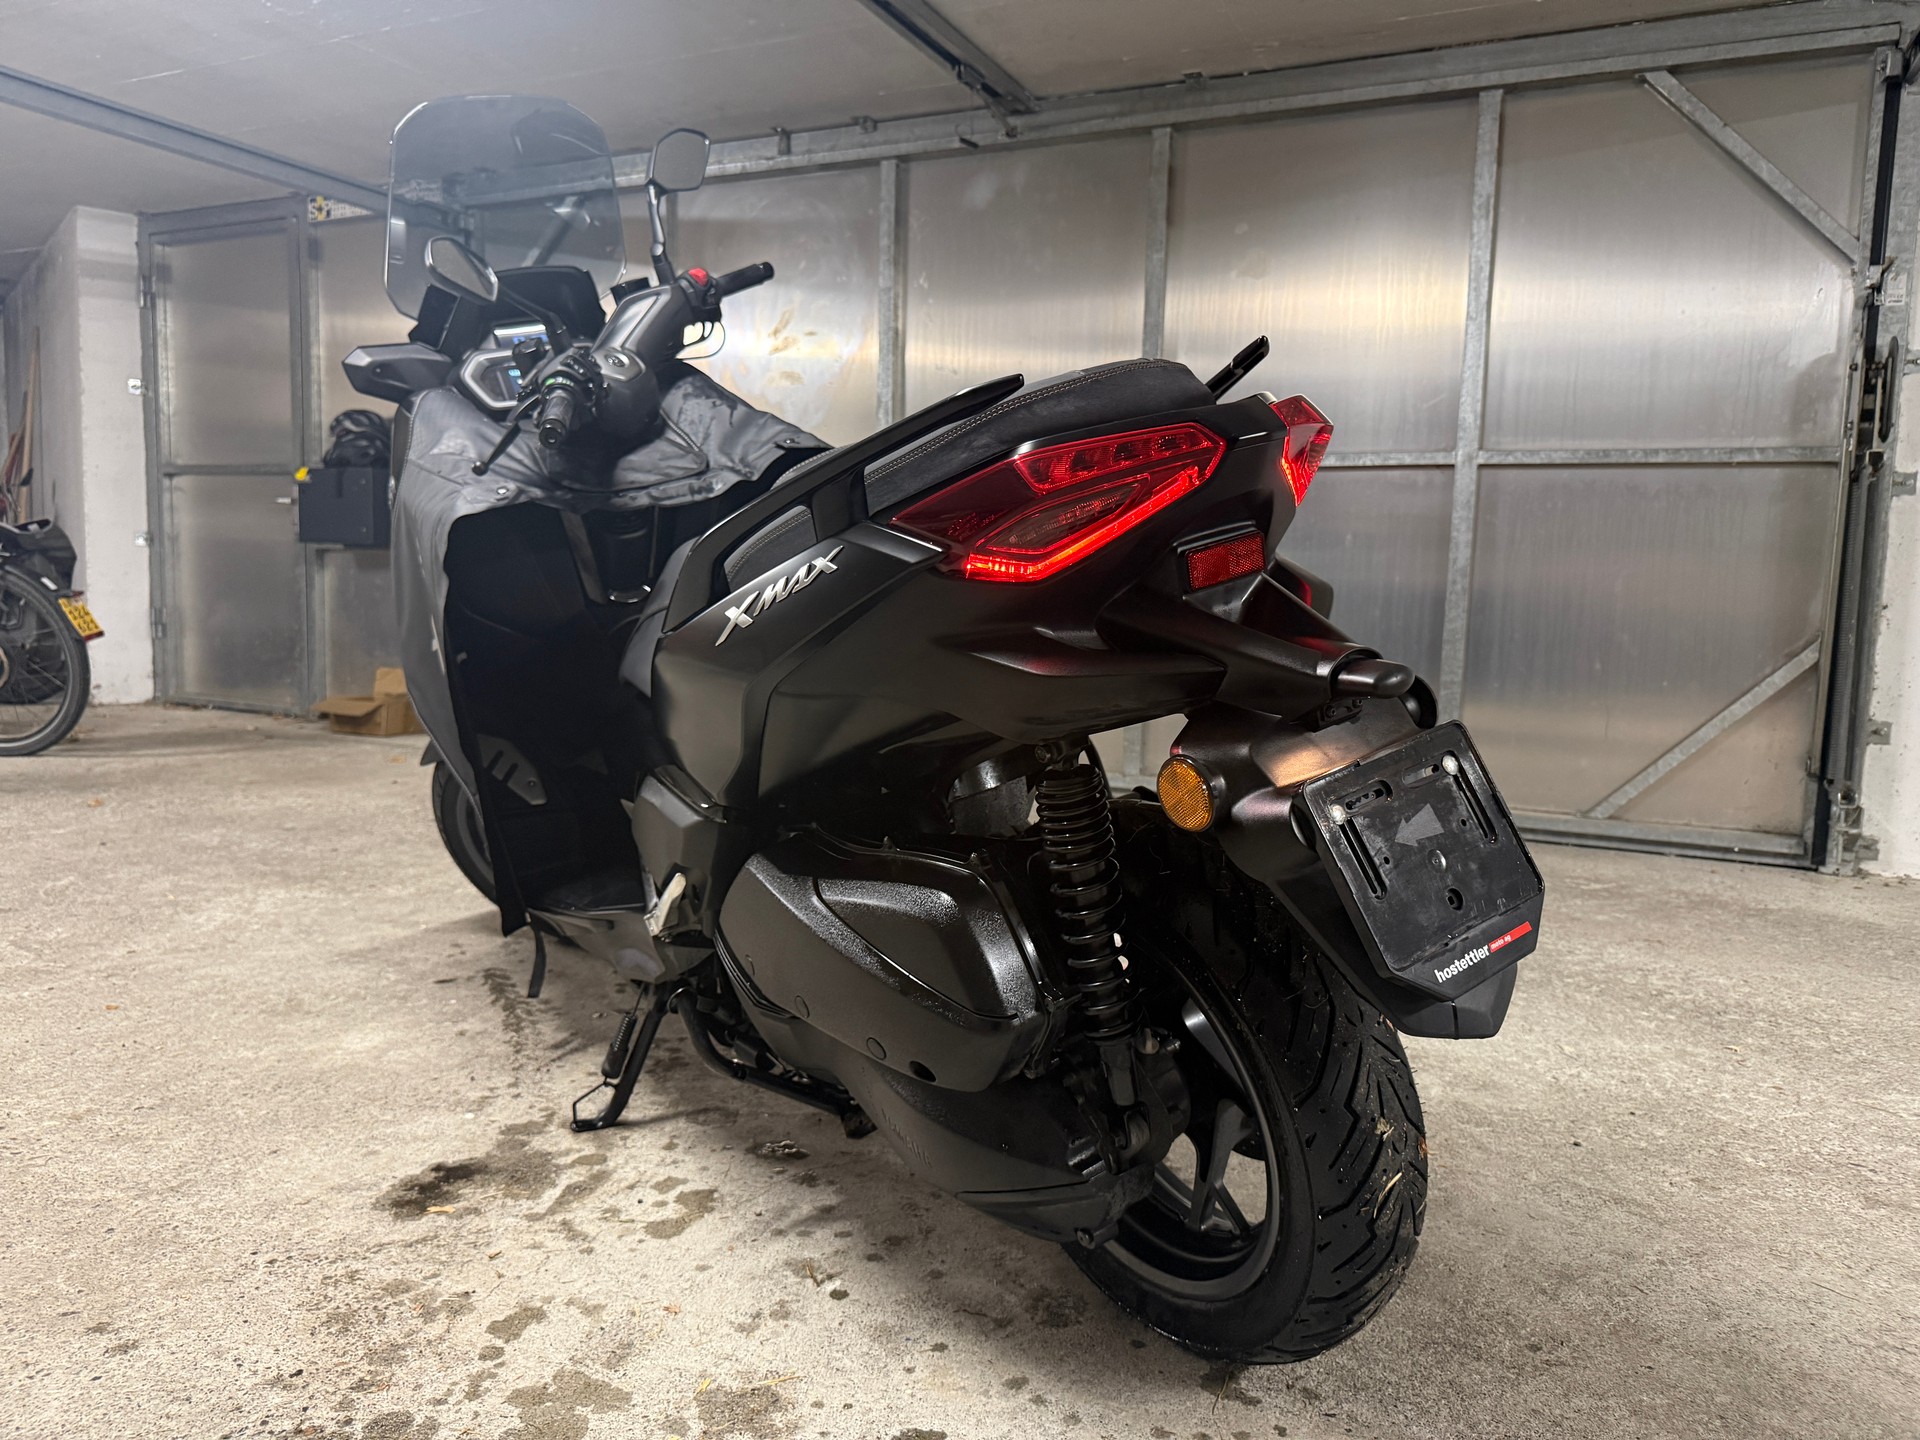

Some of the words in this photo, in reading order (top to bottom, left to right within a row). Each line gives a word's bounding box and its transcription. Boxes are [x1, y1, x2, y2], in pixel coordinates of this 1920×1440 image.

[715, 545, 844, 647] XMAX
[1434, 944, 1490, 983] hostettler
[1490, 937, 1504, 950] moto
